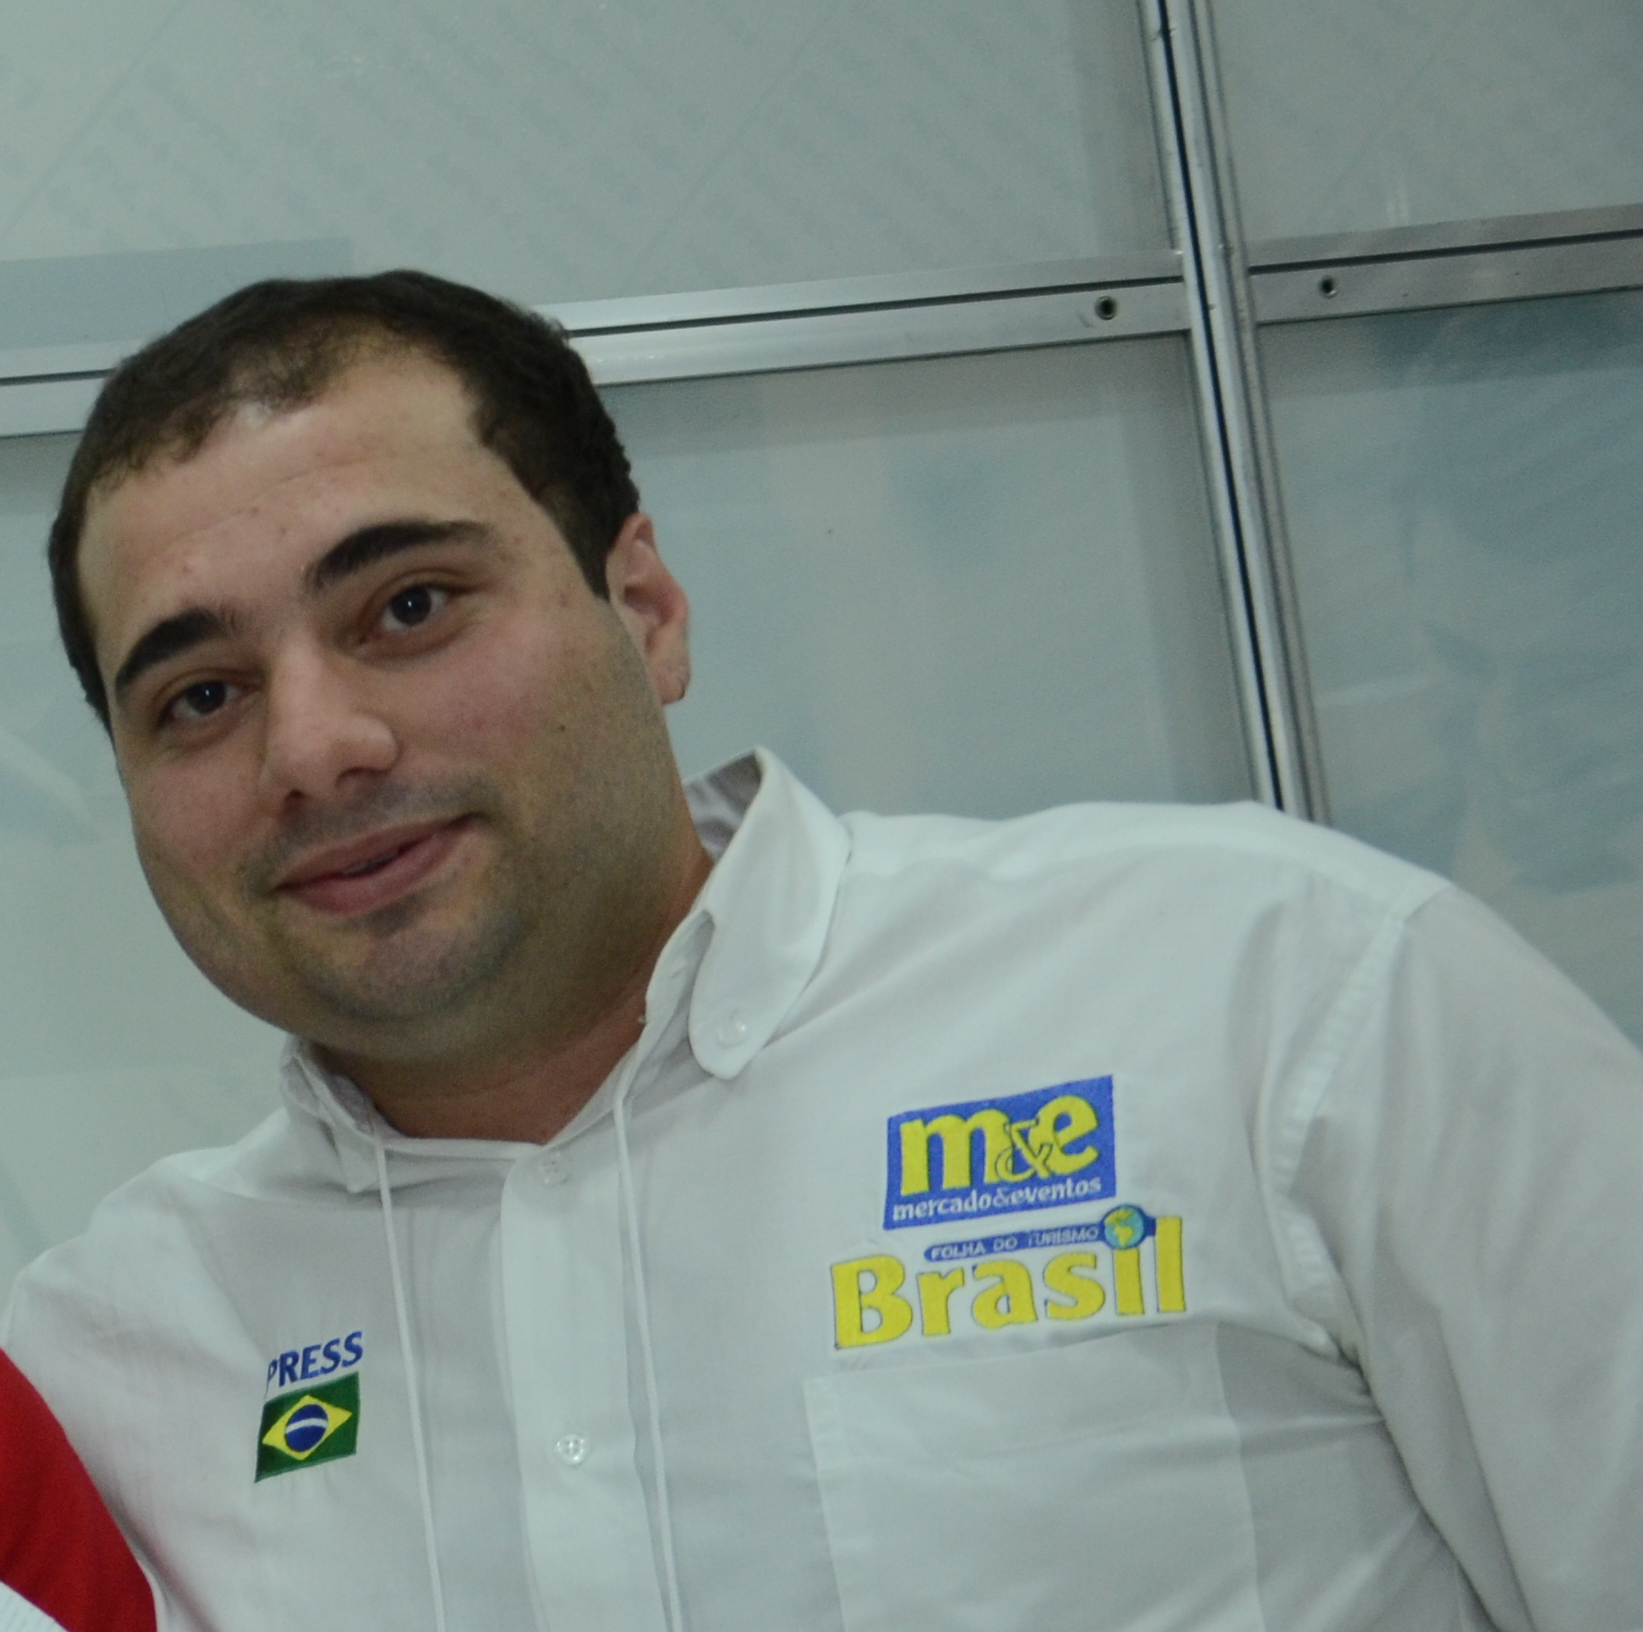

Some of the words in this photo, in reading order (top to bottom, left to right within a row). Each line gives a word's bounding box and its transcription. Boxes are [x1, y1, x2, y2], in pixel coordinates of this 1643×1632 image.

[899, 1094, 1099, 1197] m&e
[892, 1175, 1103, 1221] mercado&eventos
[993, 1235, 1019, 1251] DO
[829, 1208, 1187, 1350] Brasil
[265, 1330, 364, 1390] PRESS
